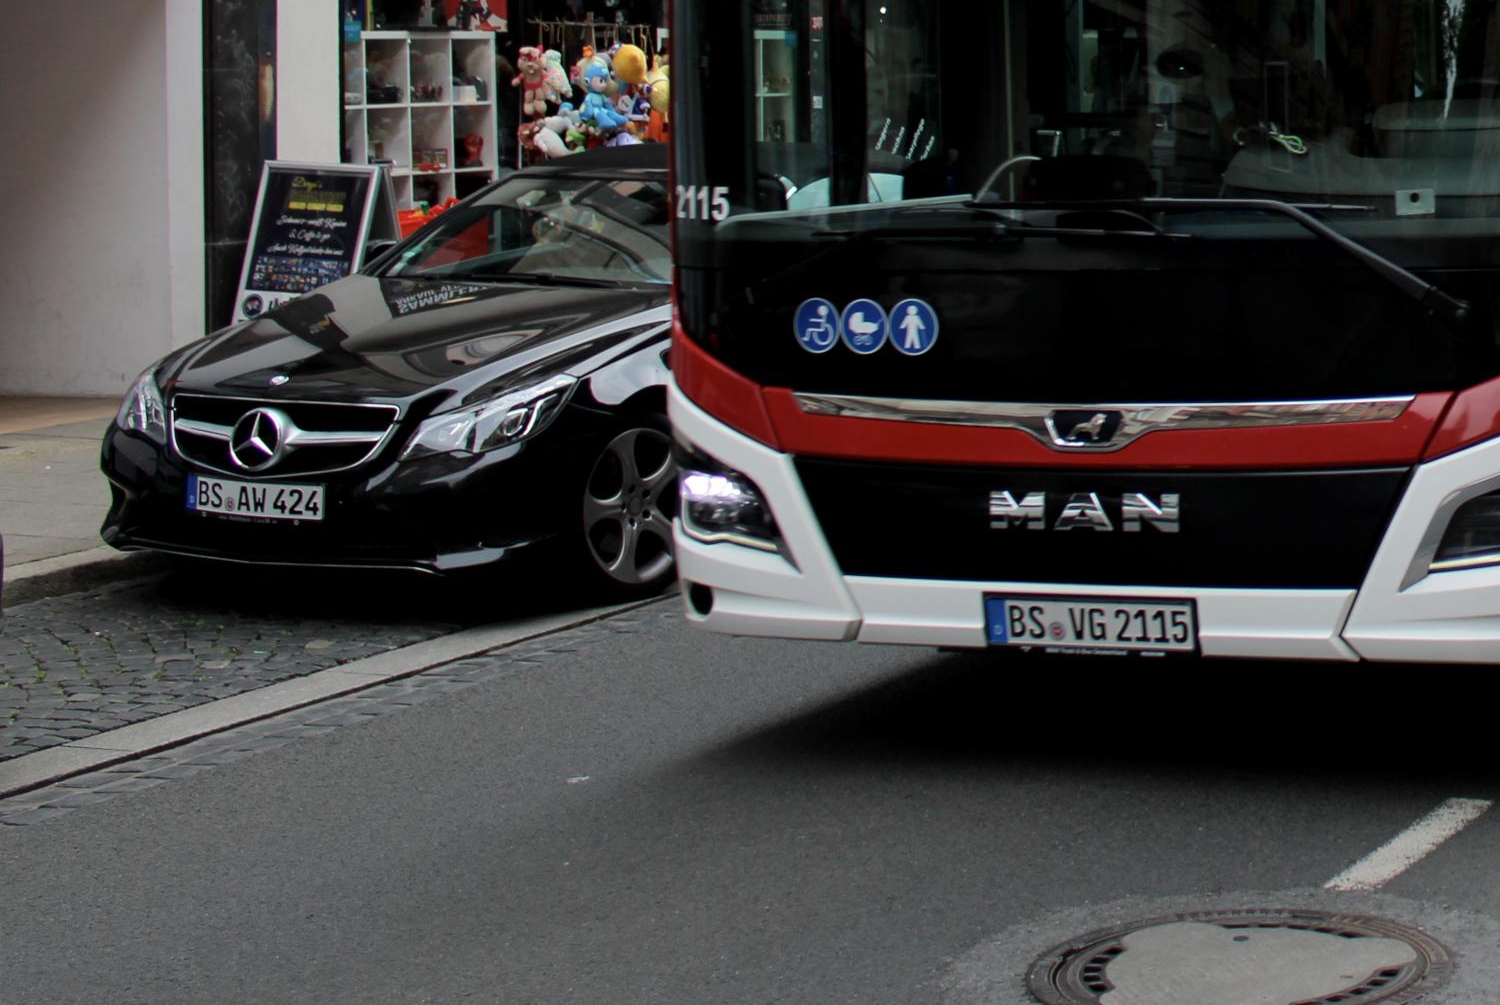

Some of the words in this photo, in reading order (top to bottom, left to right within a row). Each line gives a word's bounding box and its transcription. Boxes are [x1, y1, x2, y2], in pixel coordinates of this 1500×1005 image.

[676, 184, 730, 221] 2115
[199, 481, 223, 508] BS
[237, 486, 266, 513] AW
[272, 488, 320, 516] 424
[989, 490, 1180, 532] MAN
[1008, 605, 1046, 638] BS
[1068, 607, 1106, 641] VG
[1114, 610, 1189, 644] 2115
